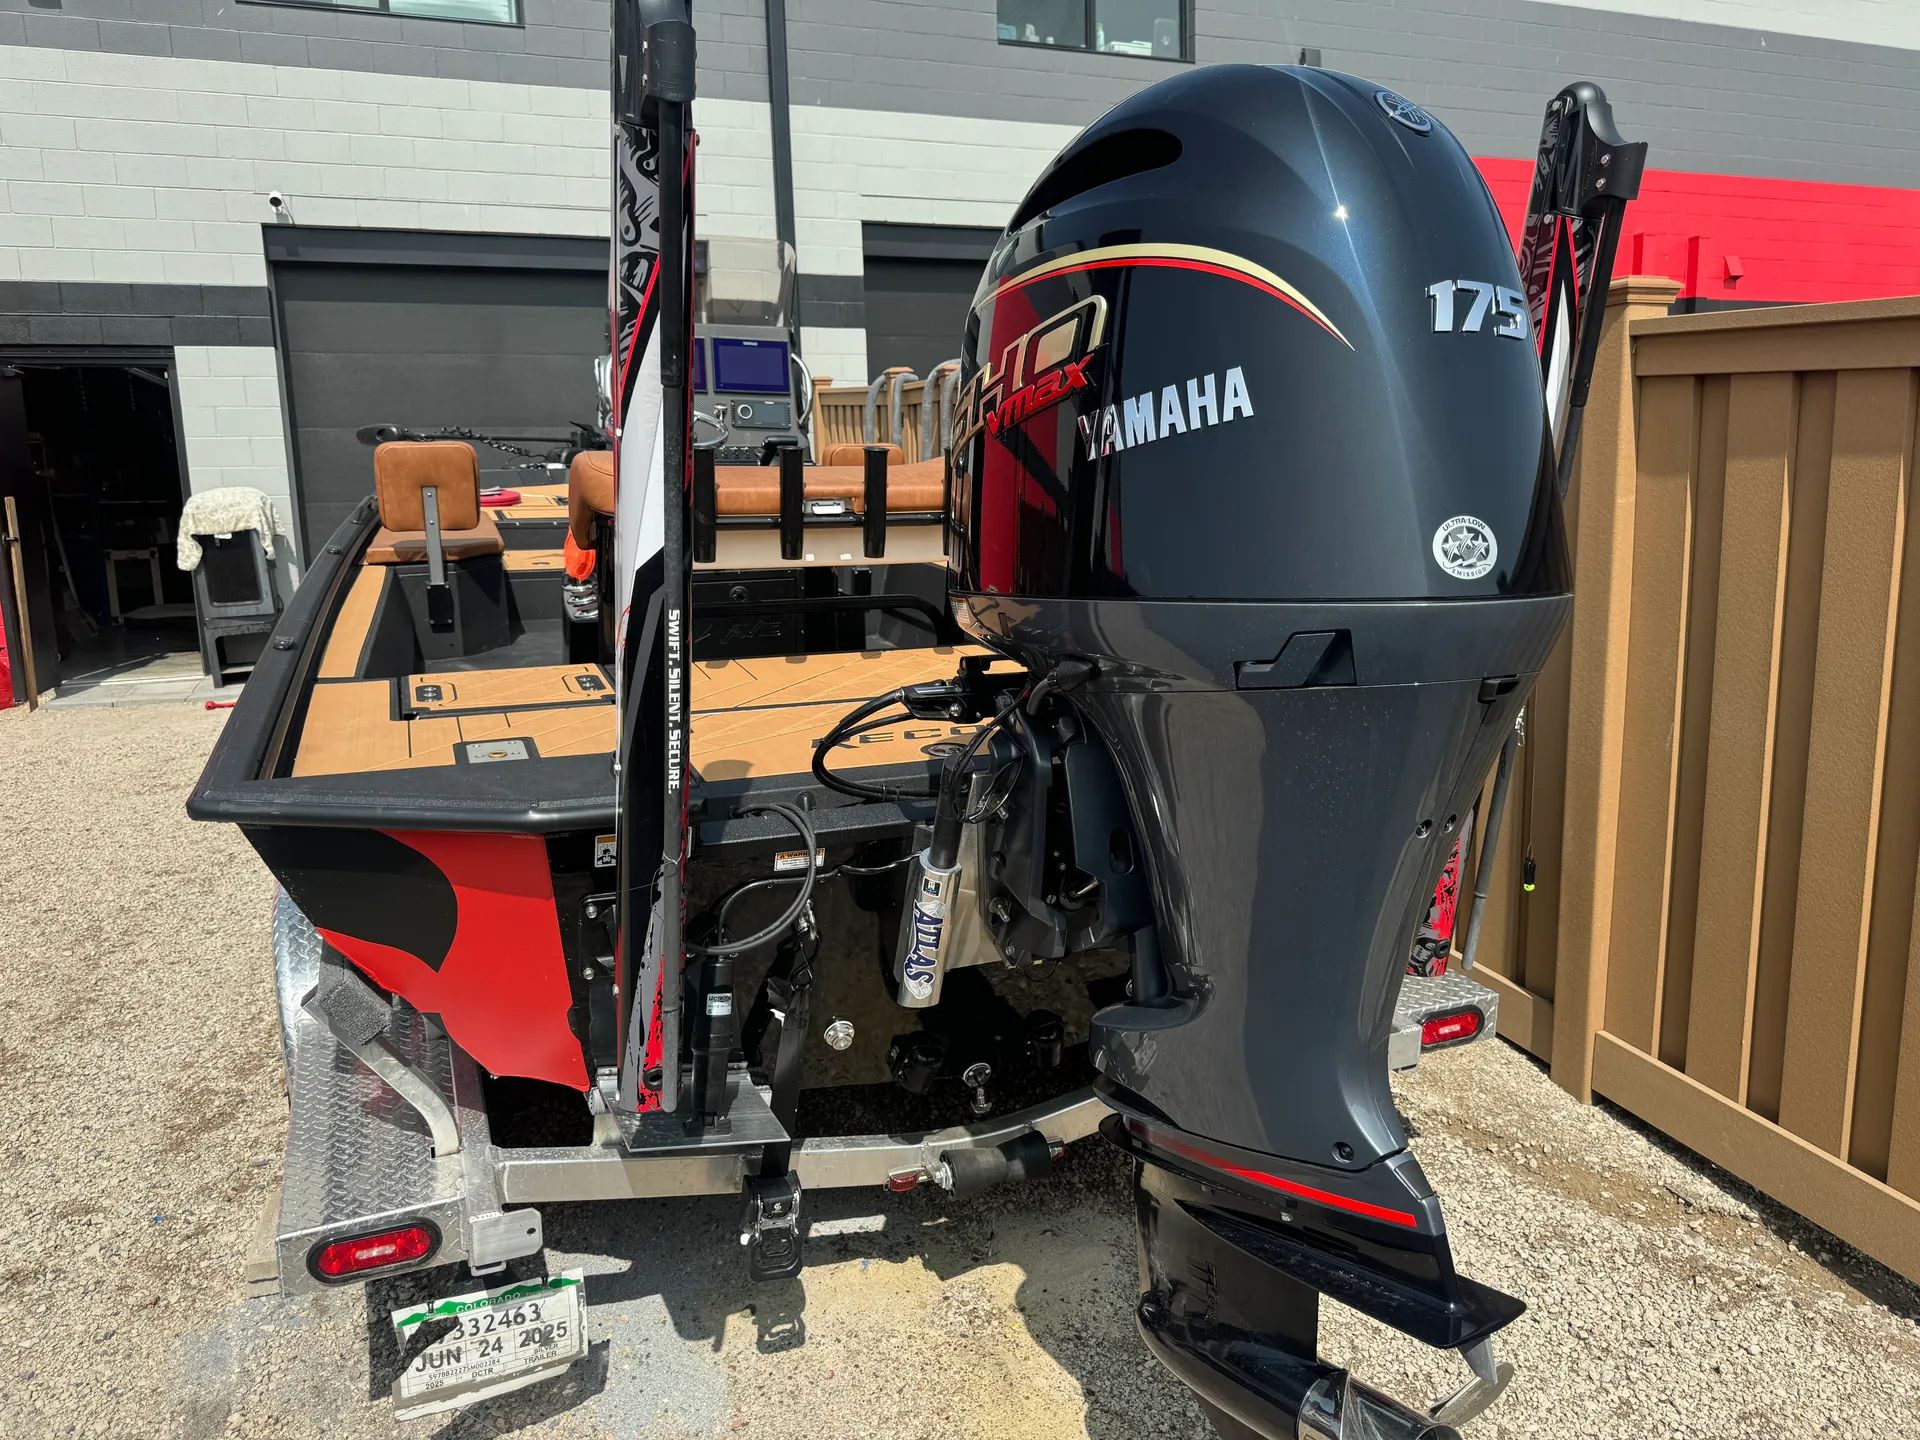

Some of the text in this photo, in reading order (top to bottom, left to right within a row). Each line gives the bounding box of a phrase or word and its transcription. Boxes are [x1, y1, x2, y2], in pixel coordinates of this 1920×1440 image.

[1425, 279, 1528, 340] 175
[1077, 365, 1254, 461] YAMAHA
[1452, 566, 1487, 577] EMISSION
[668, 609, 682, 795] SWIFT. SILENT. SECURE.
[904, 899, 944, 984] ATLAS
[456, 1292, 521, 1313] COLORADO
[415, 1321, 568, 1373] JUN 24 2025
[523, 1350, 557, 1365] TRAILER
[425, 1380, 444, 1390] 2025
[471, 1367, 494, 1378] DCTR
